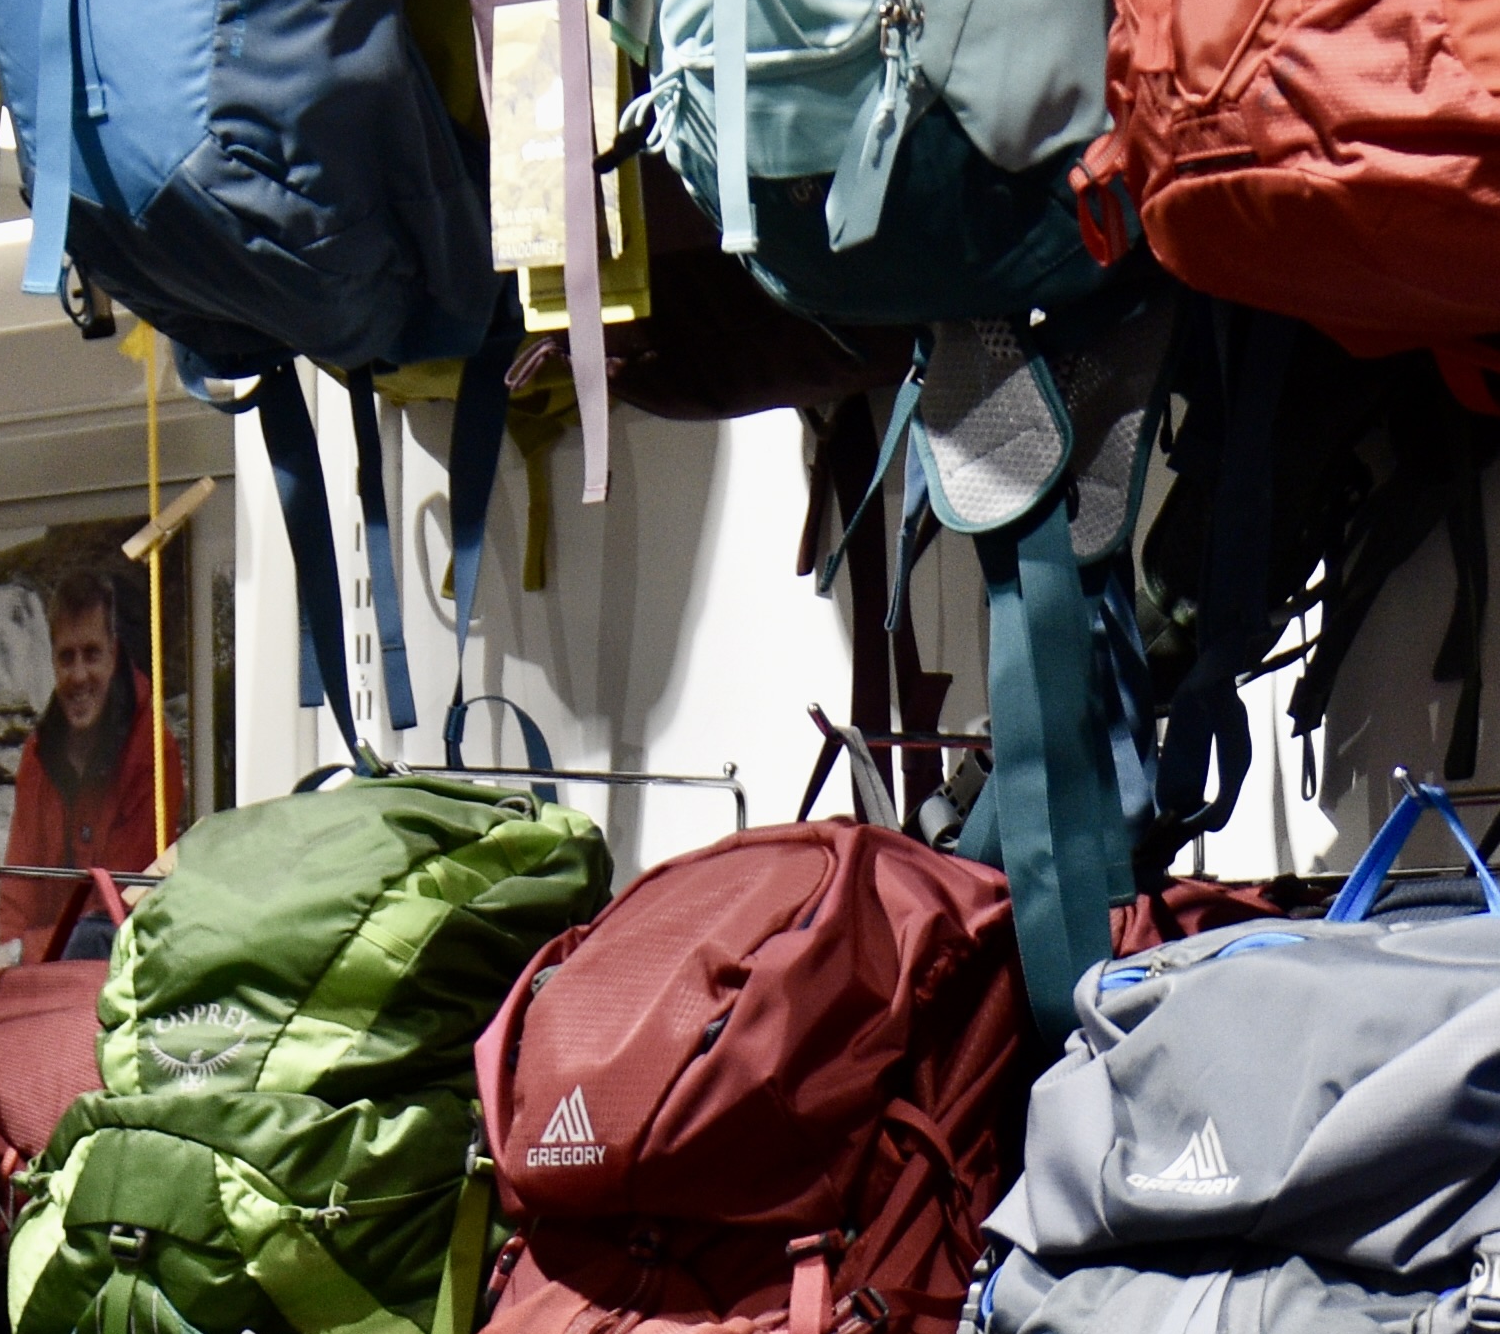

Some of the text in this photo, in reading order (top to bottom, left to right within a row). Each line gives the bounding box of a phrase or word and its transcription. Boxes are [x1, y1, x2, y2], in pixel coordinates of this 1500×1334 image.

[153, 1004, 258, 1035] OSPREY
[526, 1145, 606, 1168] GREGORY
[1127, 1170, 1241, 1198] GREGORY
